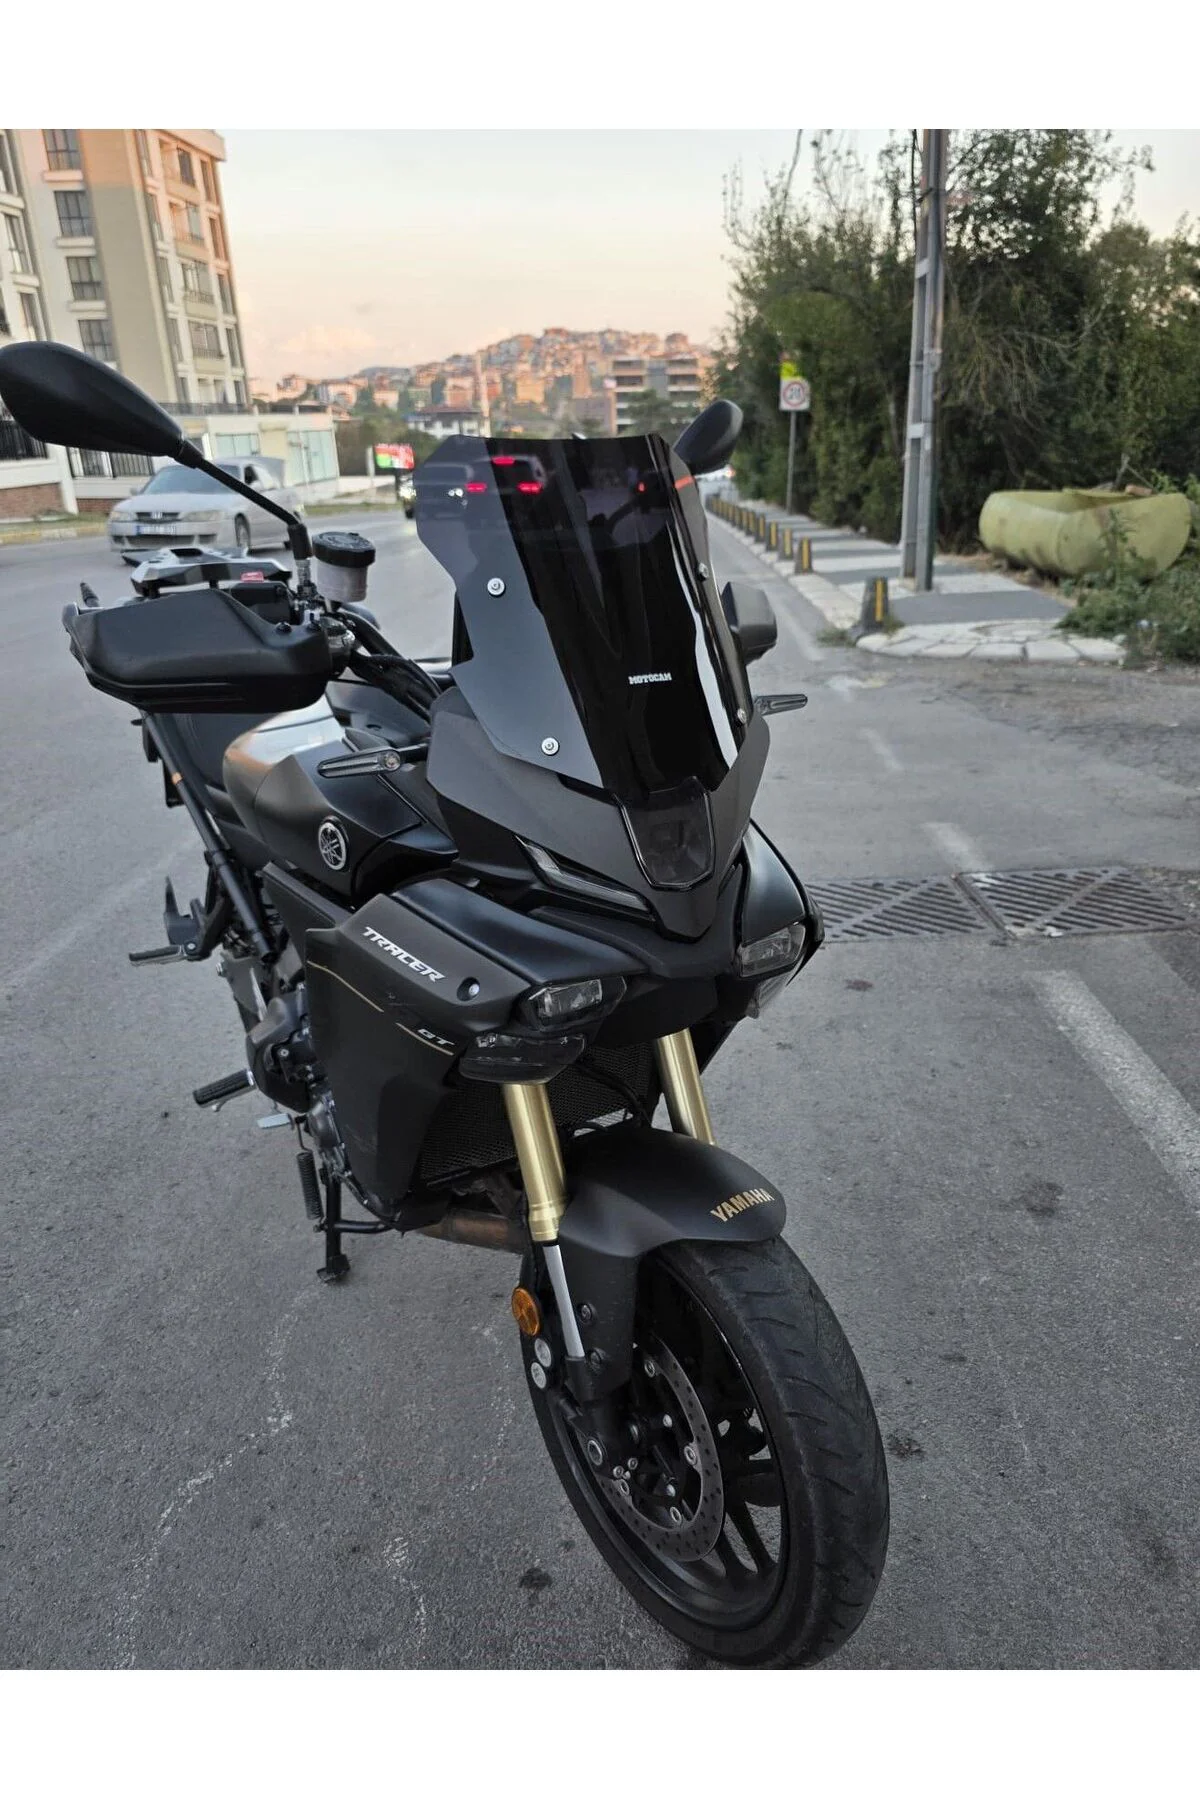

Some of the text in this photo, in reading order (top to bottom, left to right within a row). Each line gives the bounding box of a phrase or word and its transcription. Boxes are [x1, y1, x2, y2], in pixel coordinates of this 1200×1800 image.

[628, 672, 672, 684] MOTOCAM
[363, 926, 446, 983] TRACER
[418, 1028, 455, 1046] GT
[709, 1188, 775, 1222] YAMAHA
